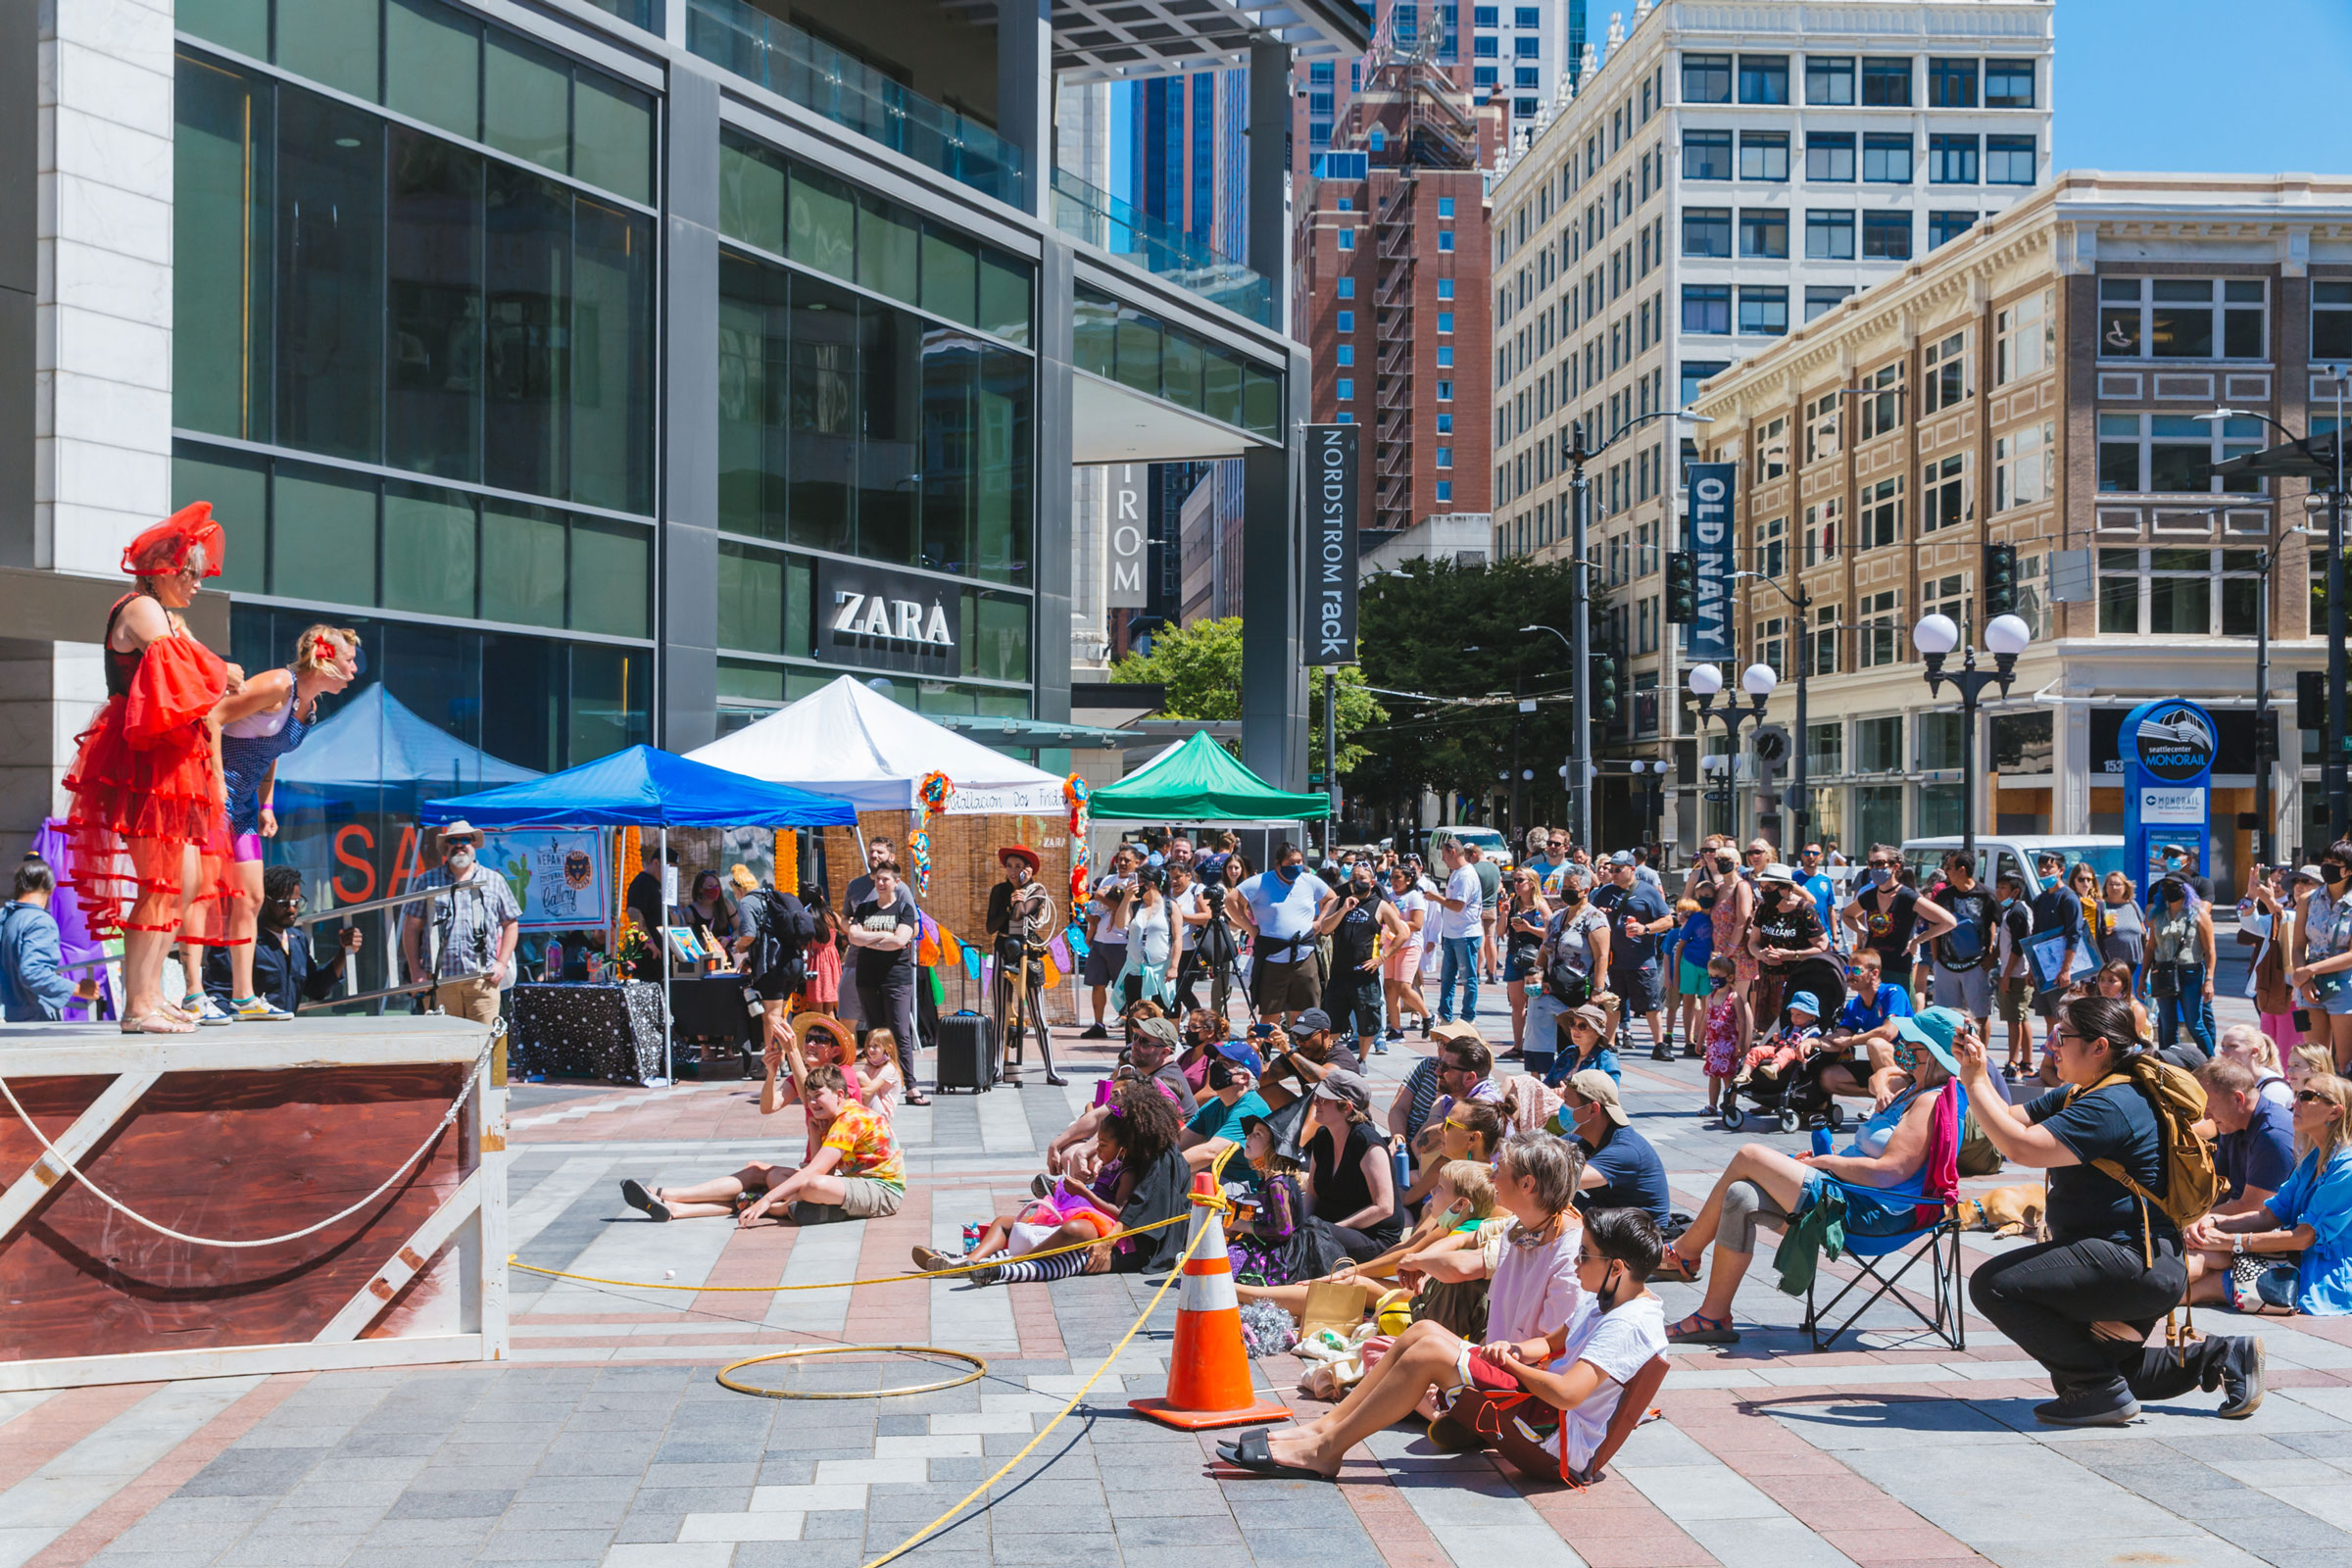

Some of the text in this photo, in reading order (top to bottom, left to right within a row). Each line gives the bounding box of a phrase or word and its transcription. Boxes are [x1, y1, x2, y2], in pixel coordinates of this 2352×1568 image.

[1321, 430, 1348, 657] NORDSTROM rack
[1696, 477, 1726, 645] OLD NAVY
[834, 591, 955, 645] ZARA
[2145, 754, 2206, 765] MONORAIL
[1013, 791, 1029, 808] Dos
[2158, 796, 2200, 805] MONORAIL
[331, 824, 449, 904] SA
[537, 854, 565, 866] NEPANT
